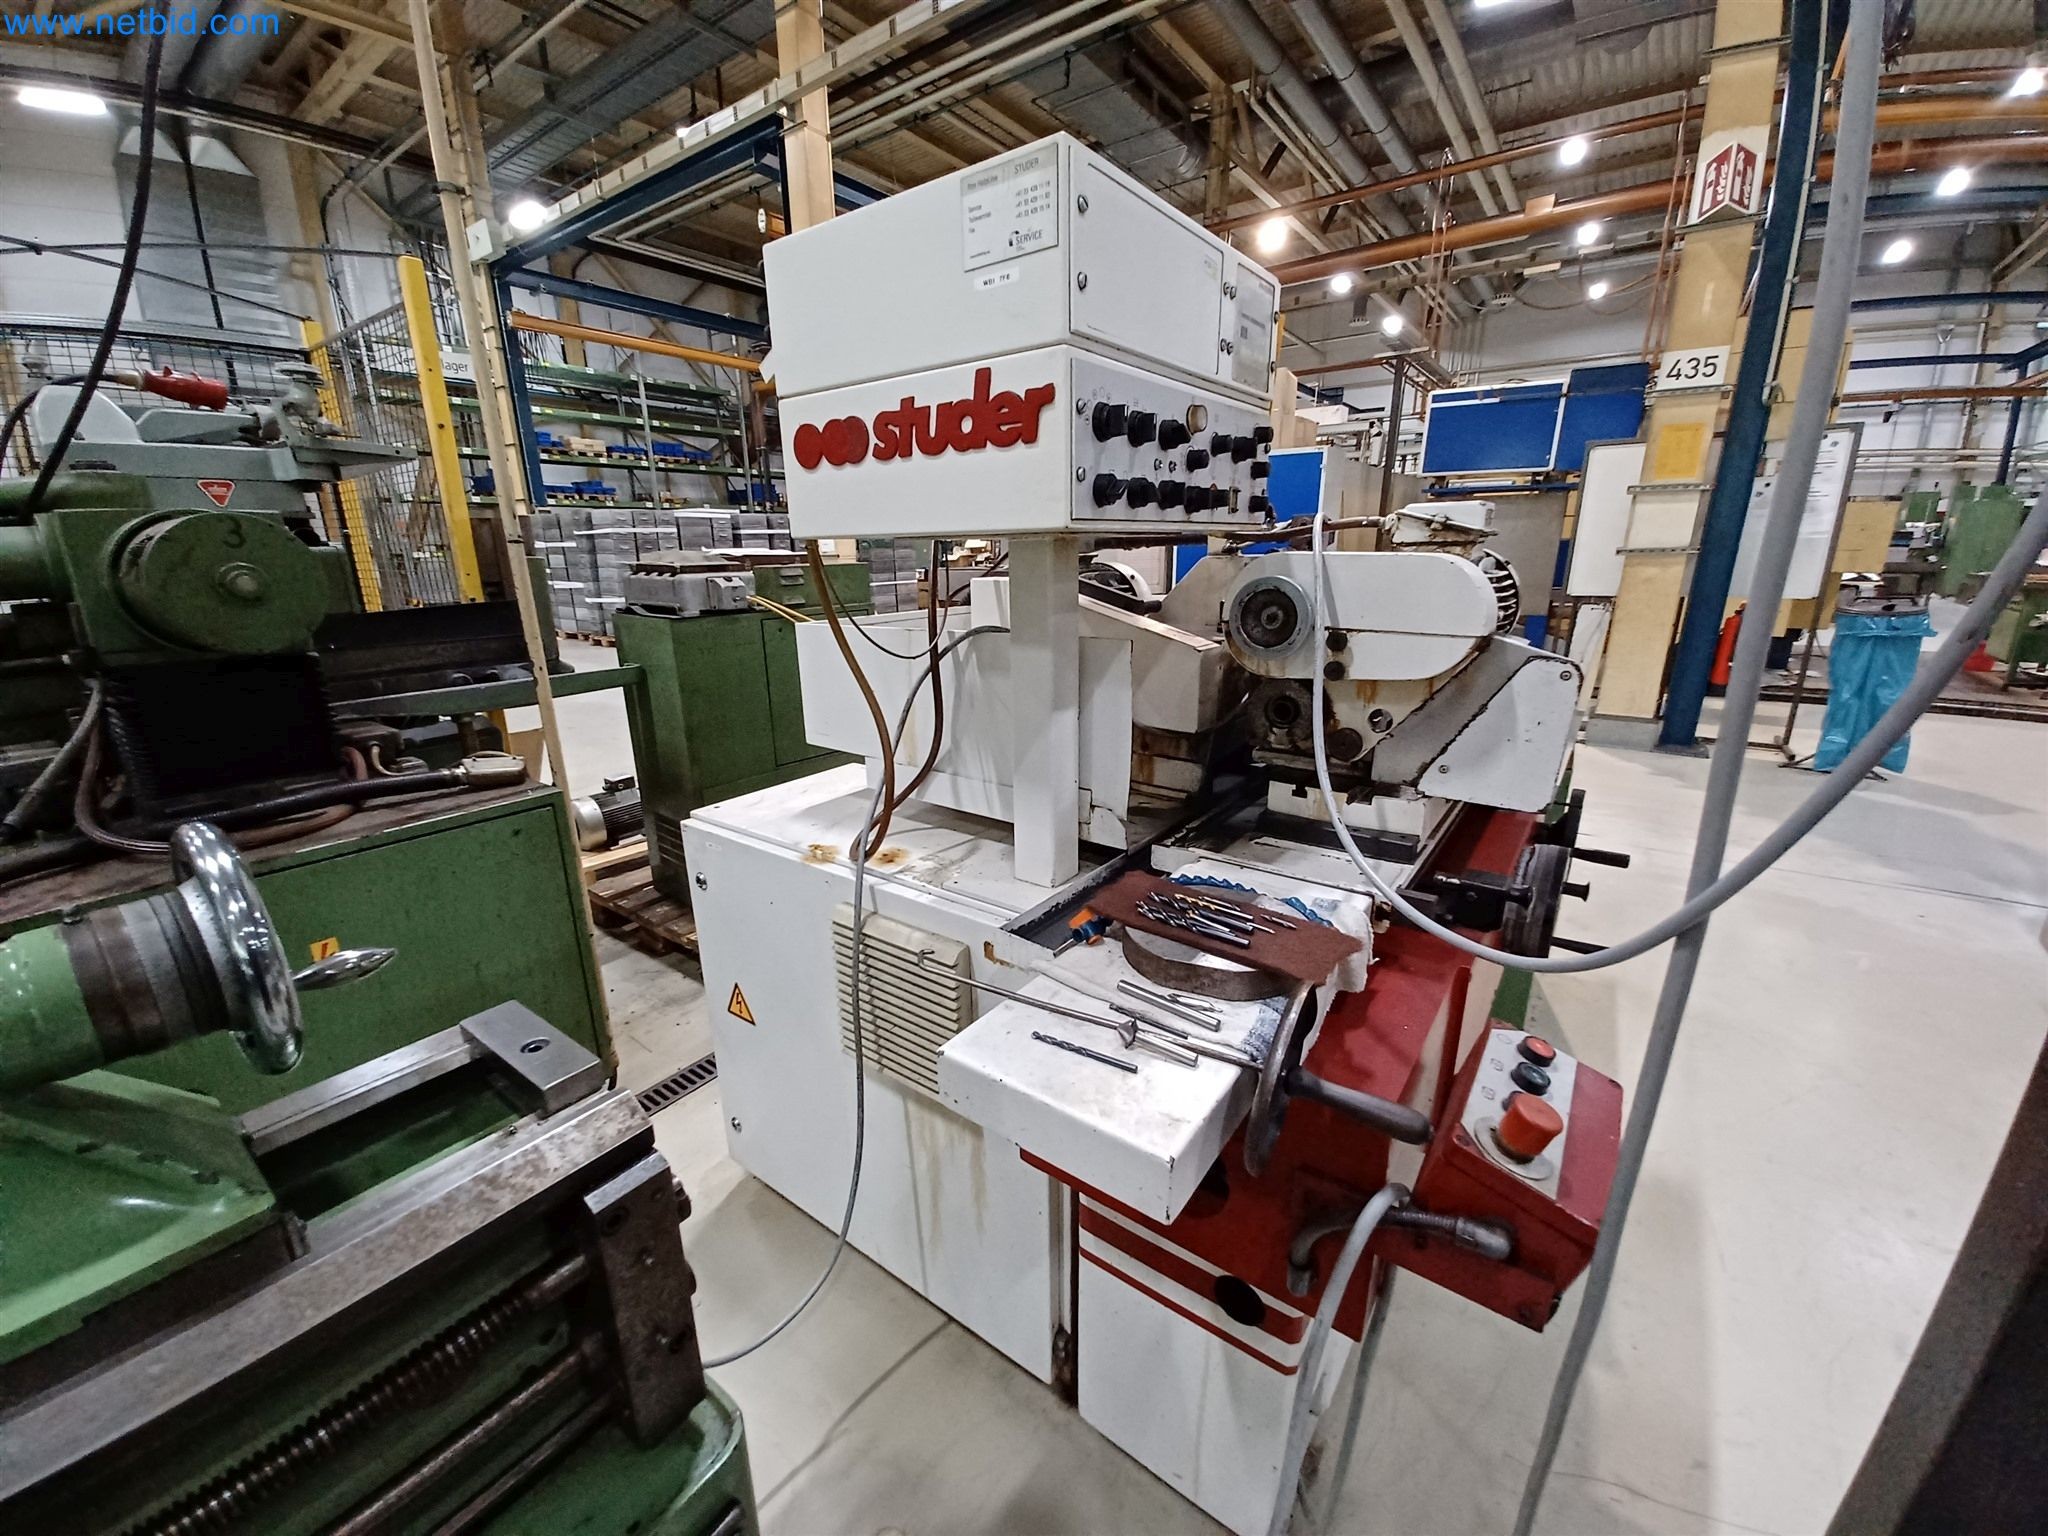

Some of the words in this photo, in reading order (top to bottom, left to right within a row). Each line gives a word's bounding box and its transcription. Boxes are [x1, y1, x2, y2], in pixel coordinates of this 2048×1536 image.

[1014, 156, 1040, 175] STUDER
[1015, 229, 1043, 246] SERVICE
[1665, 354, 1720, 381] 435
[872, 366, 1056, 461] studer
[222, 516, 247, 549] 3
